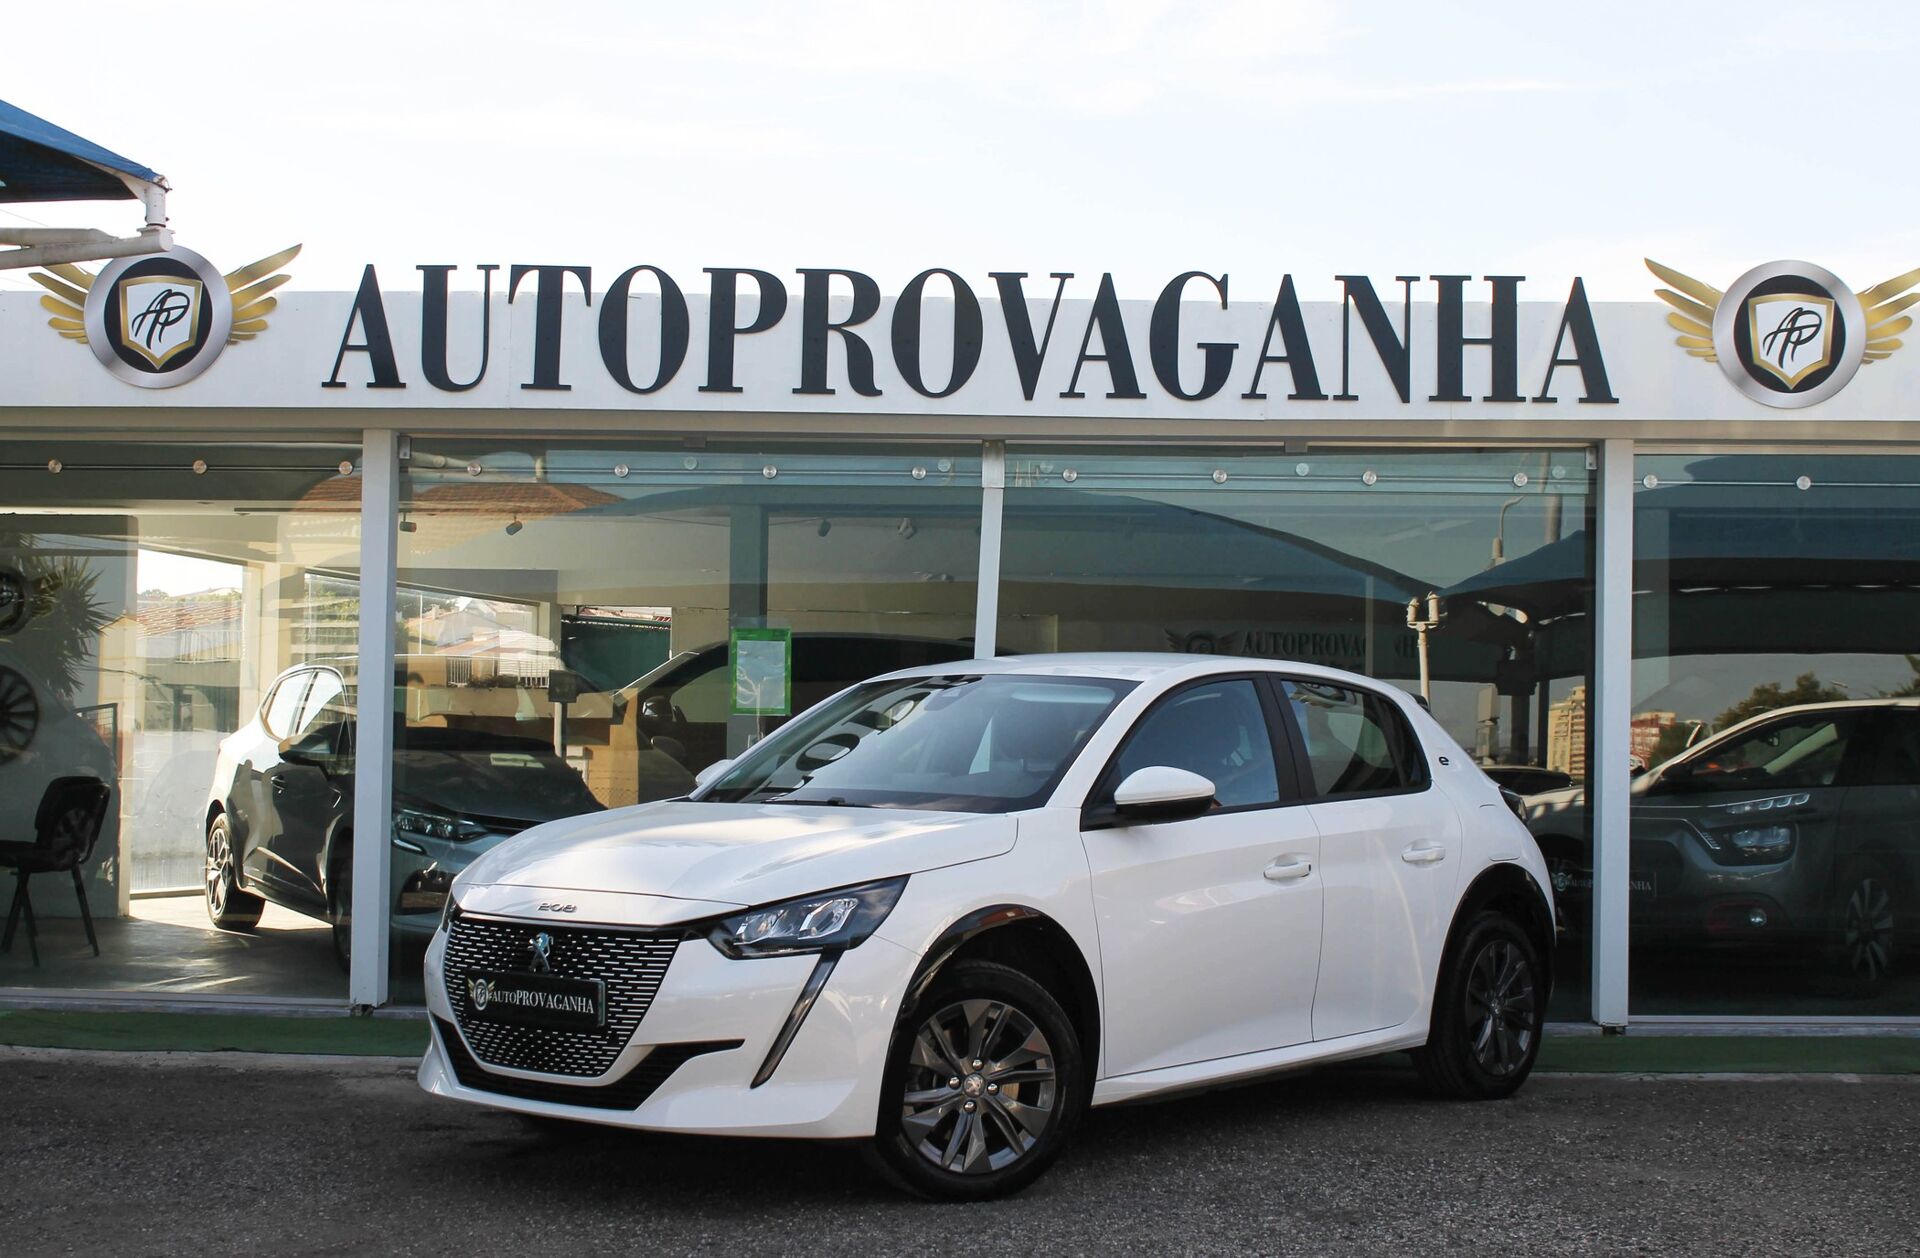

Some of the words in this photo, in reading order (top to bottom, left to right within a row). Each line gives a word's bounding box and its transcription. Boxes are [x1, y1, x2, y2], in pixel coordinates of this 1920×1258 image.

[321, 263, 1620, 405] AUTOPROVAGANHA
[537, 903, 577, 913] 208
[492, 989, 595, 1014] AUTOPROVAGANHA
